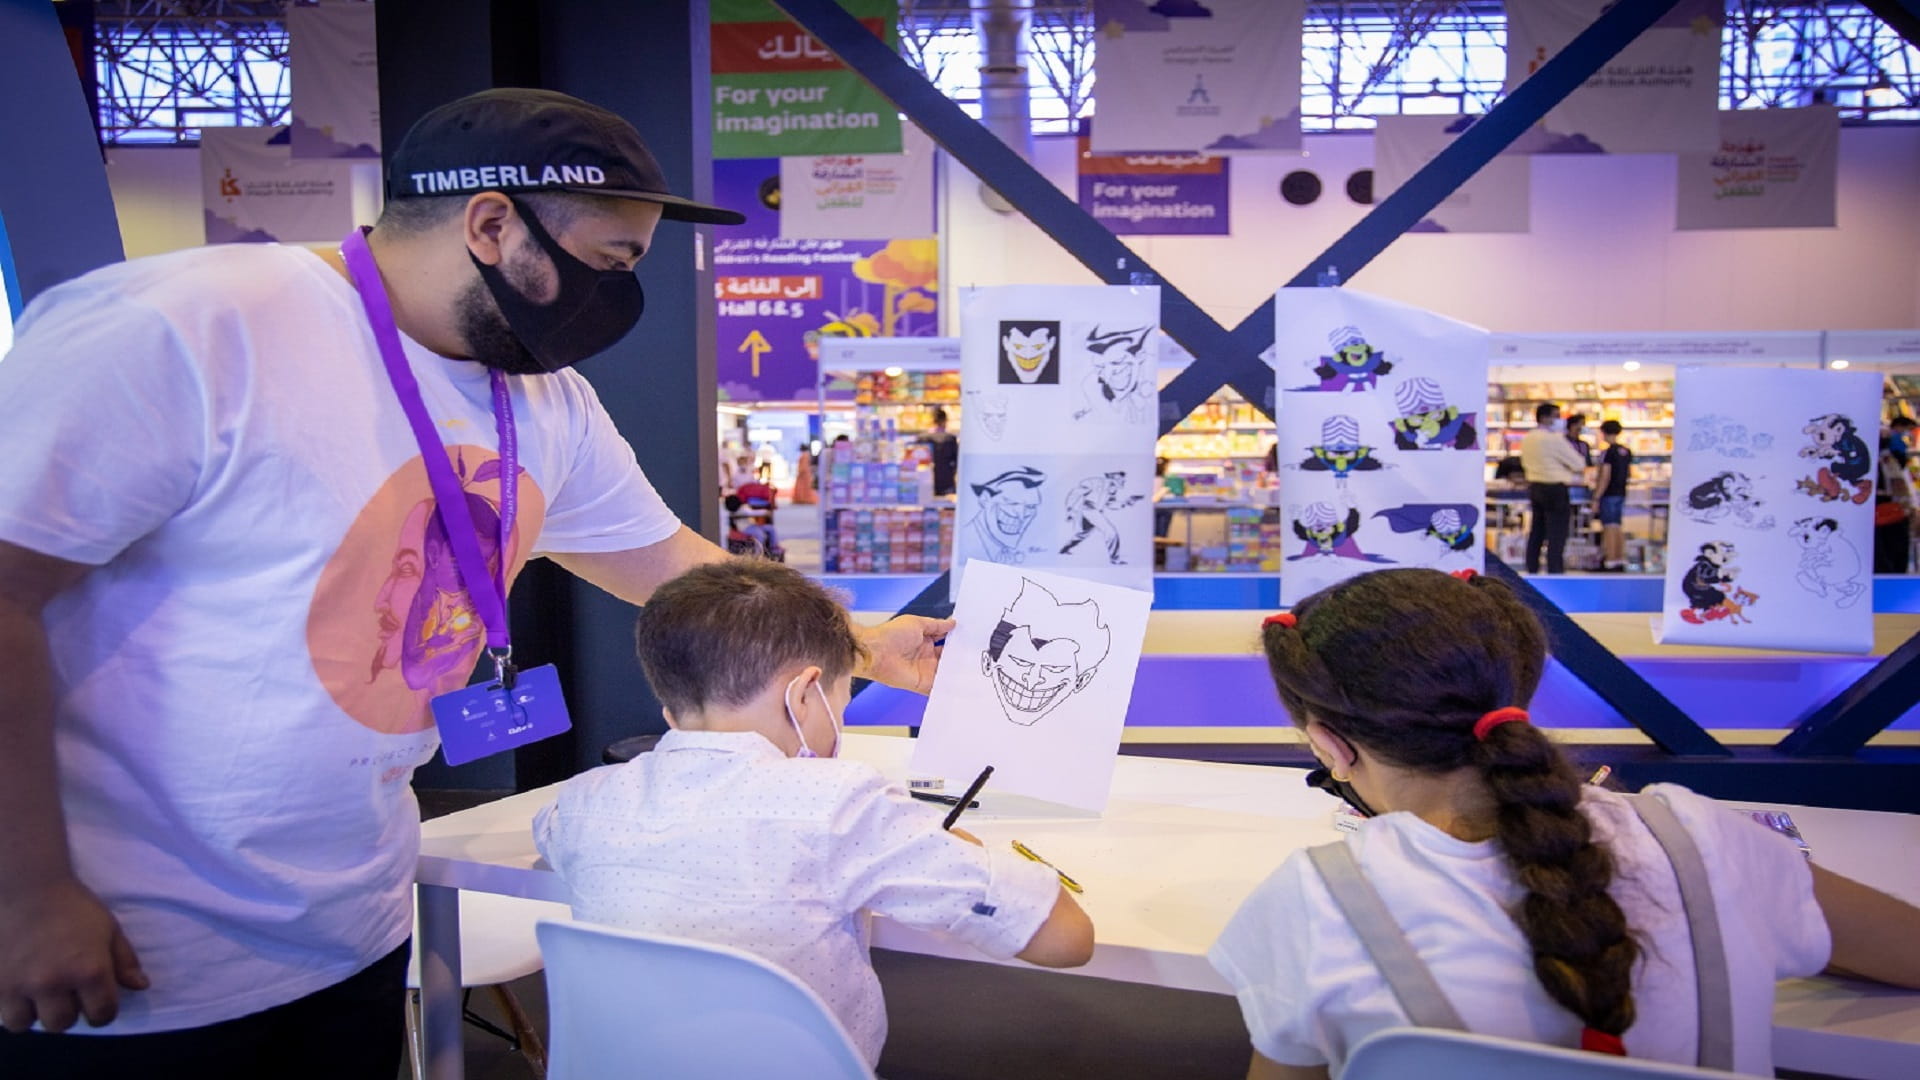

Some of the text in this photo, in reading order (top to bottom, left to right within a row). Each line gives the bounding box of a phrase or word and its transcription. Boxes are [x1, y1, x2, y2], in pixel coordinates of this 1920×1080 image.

[715, 85, 829, 107] For your
[716, 108, 879, 136] imagination
[411, 165, 606, 194] TIMBERLAND
[1093, 182, 1178, 201] For your
[1092, 201, 1215, 222] imagination
[728, 277, 780, 295] القاعة
[784, 277, 817, 298] إلى
[718, 300, 804, 318] Hall 6 & 5
